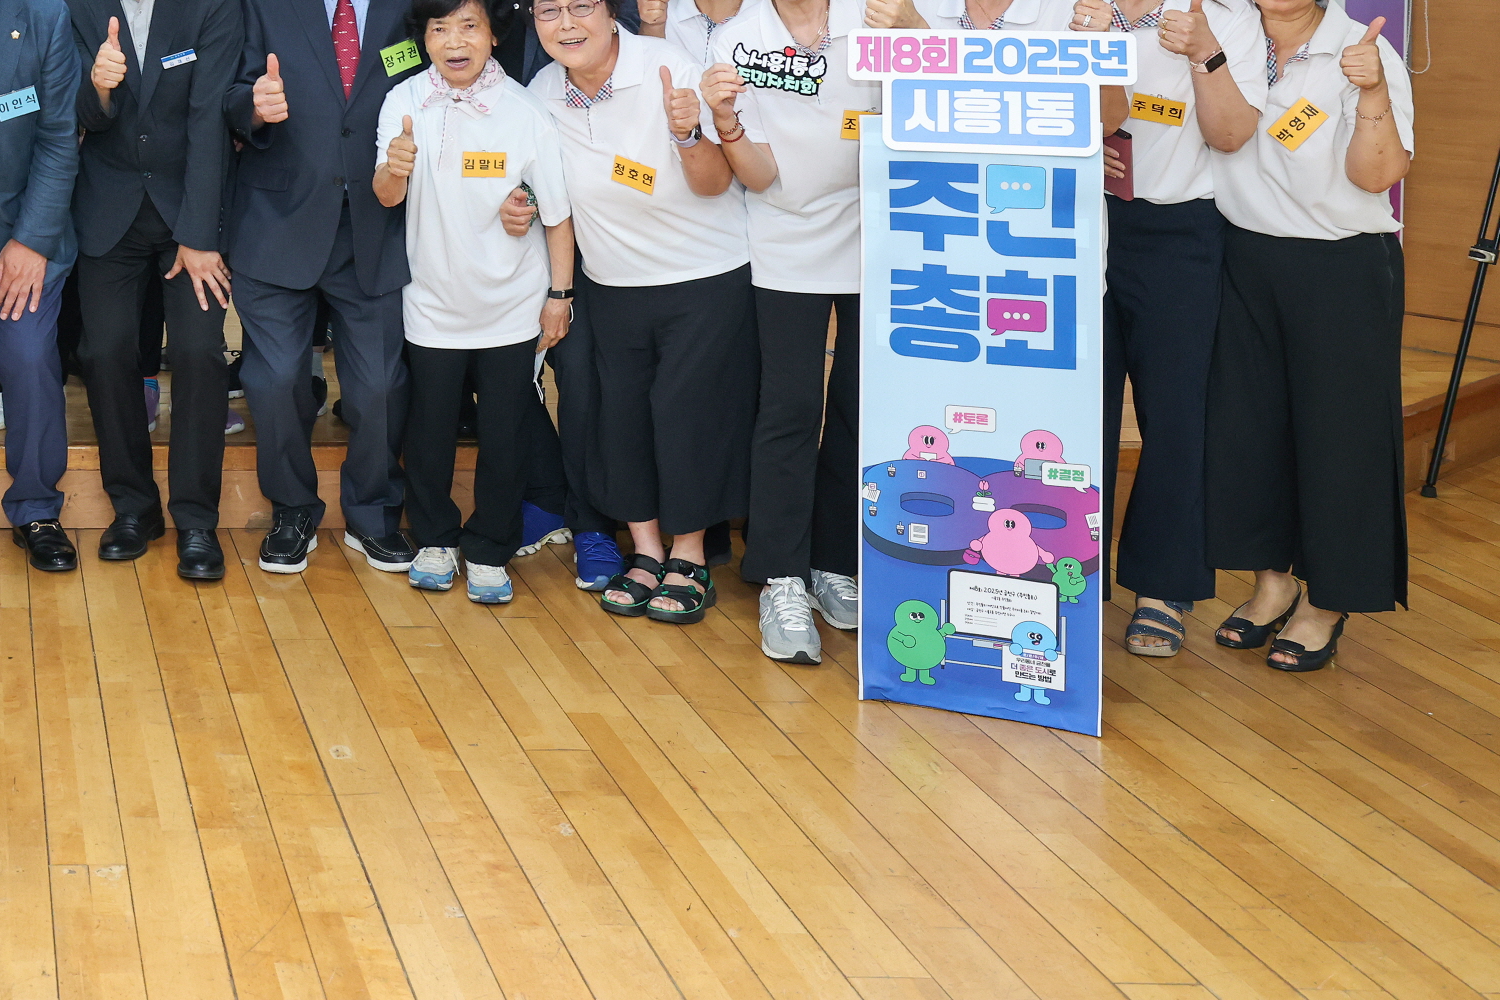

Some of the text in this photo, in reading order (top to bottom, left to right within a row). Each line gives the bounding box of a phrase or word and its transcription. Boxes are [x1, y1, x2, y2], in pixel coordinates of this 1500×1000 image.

[856, 35, 1129, 77] 제8회 2025년
[904, 88, 1075, 137] 시흥1동
[614, 162, 654, 187] 정호연
[888, 160, 1077, 260] 주민
[888, 263, 1077, 371] 총회
[952, 412, 989, 427] #토론
